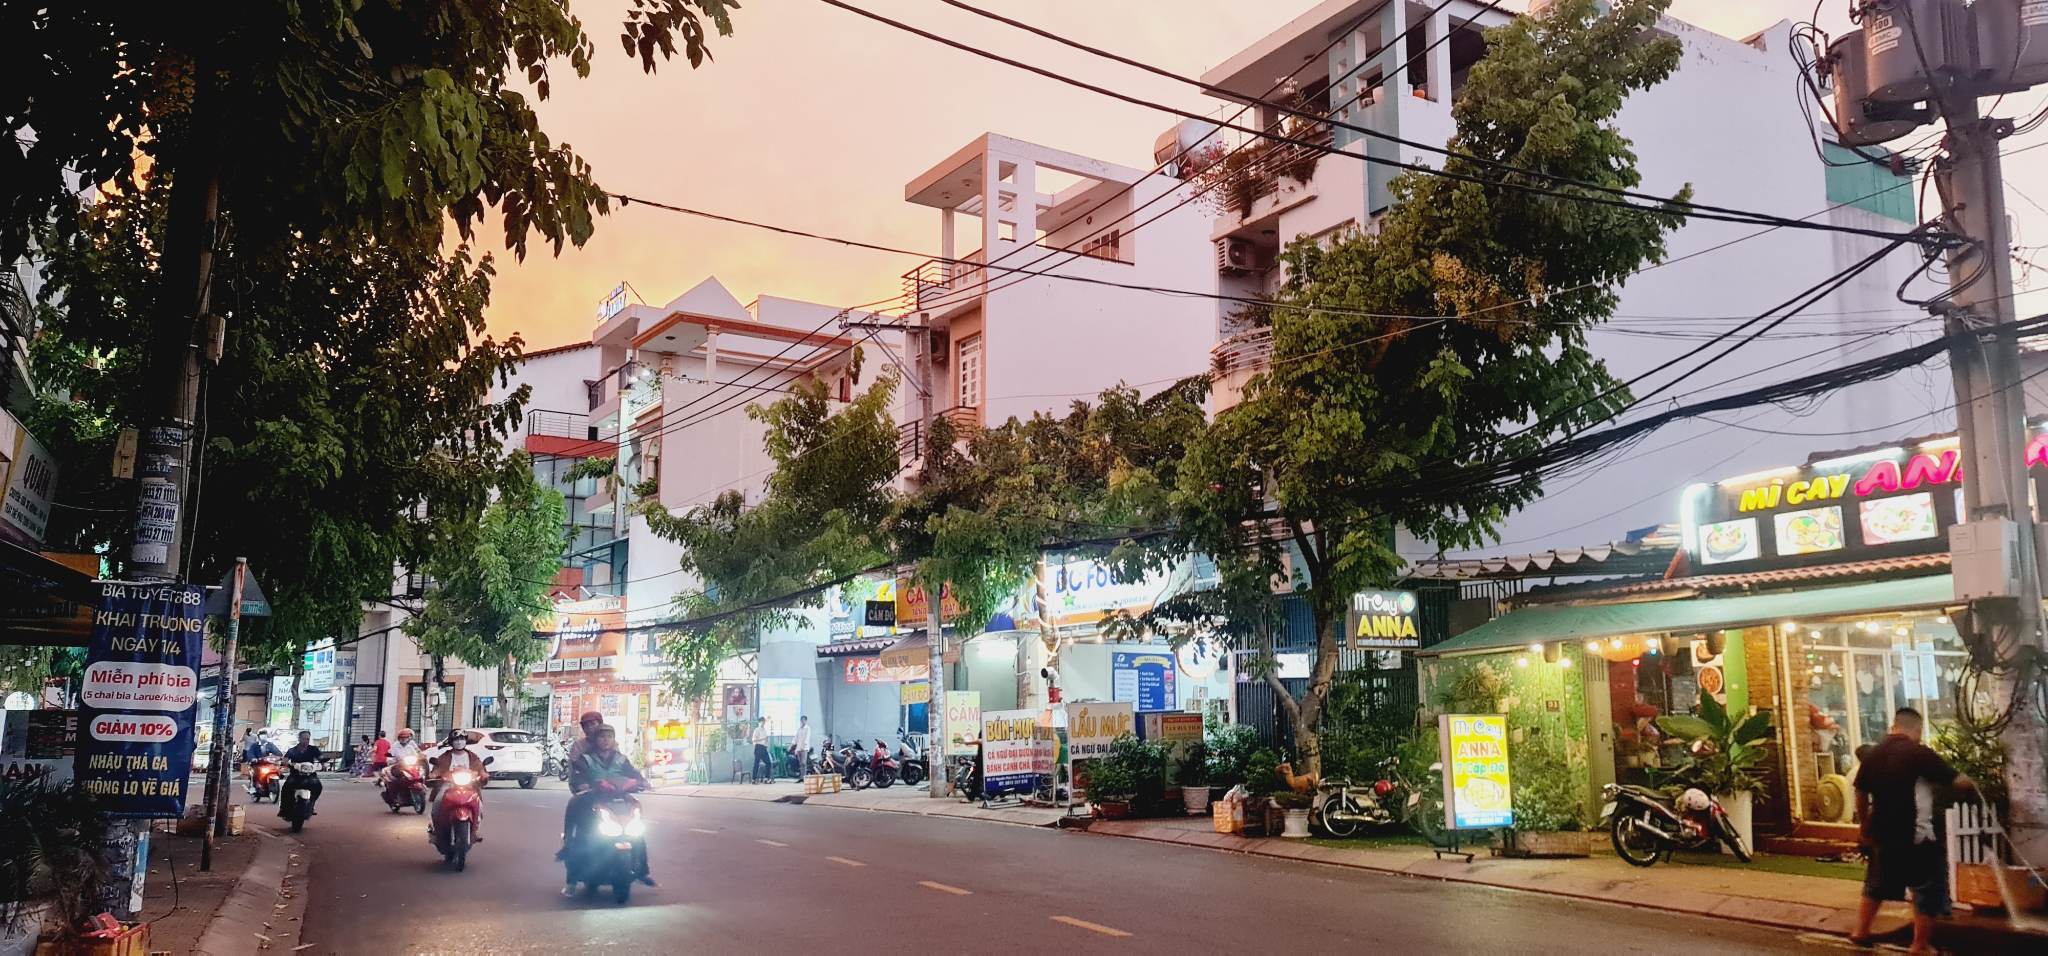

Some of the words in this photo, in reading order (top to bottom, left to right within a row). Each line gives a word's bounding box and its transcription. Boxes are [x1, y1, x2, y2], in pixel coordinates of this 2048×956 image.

[1786, 473, 1850, 506] CAY
[101, 584, 126, 599] BIA
[96, 610, 136, 627] KHAI
[1357, 614, 1418, 638] ANNA
[112, 634, 159, 653] NGÀY
[161, 639, 181, 655] 1/4
[91, 668, 134, 685] Miễn
[137, 671, 165, 689] phí
[167, 674, 192, 688] bia
[83, 691, 93, 700] (5
[94, 690, 115, 701] chai
[116, 691, 131, 701] bia
[95, 718, 136, 735] GIẢM
[139, 723, 173, 737] 10%
[1458, 742, 1502, 758] ANNA
[88, 751, 123, 774] NHẬU
[151, 755, 169, 771] GA
[123, 781, 139, 796] LO
[159, 778, 181, 796] GIÁ
